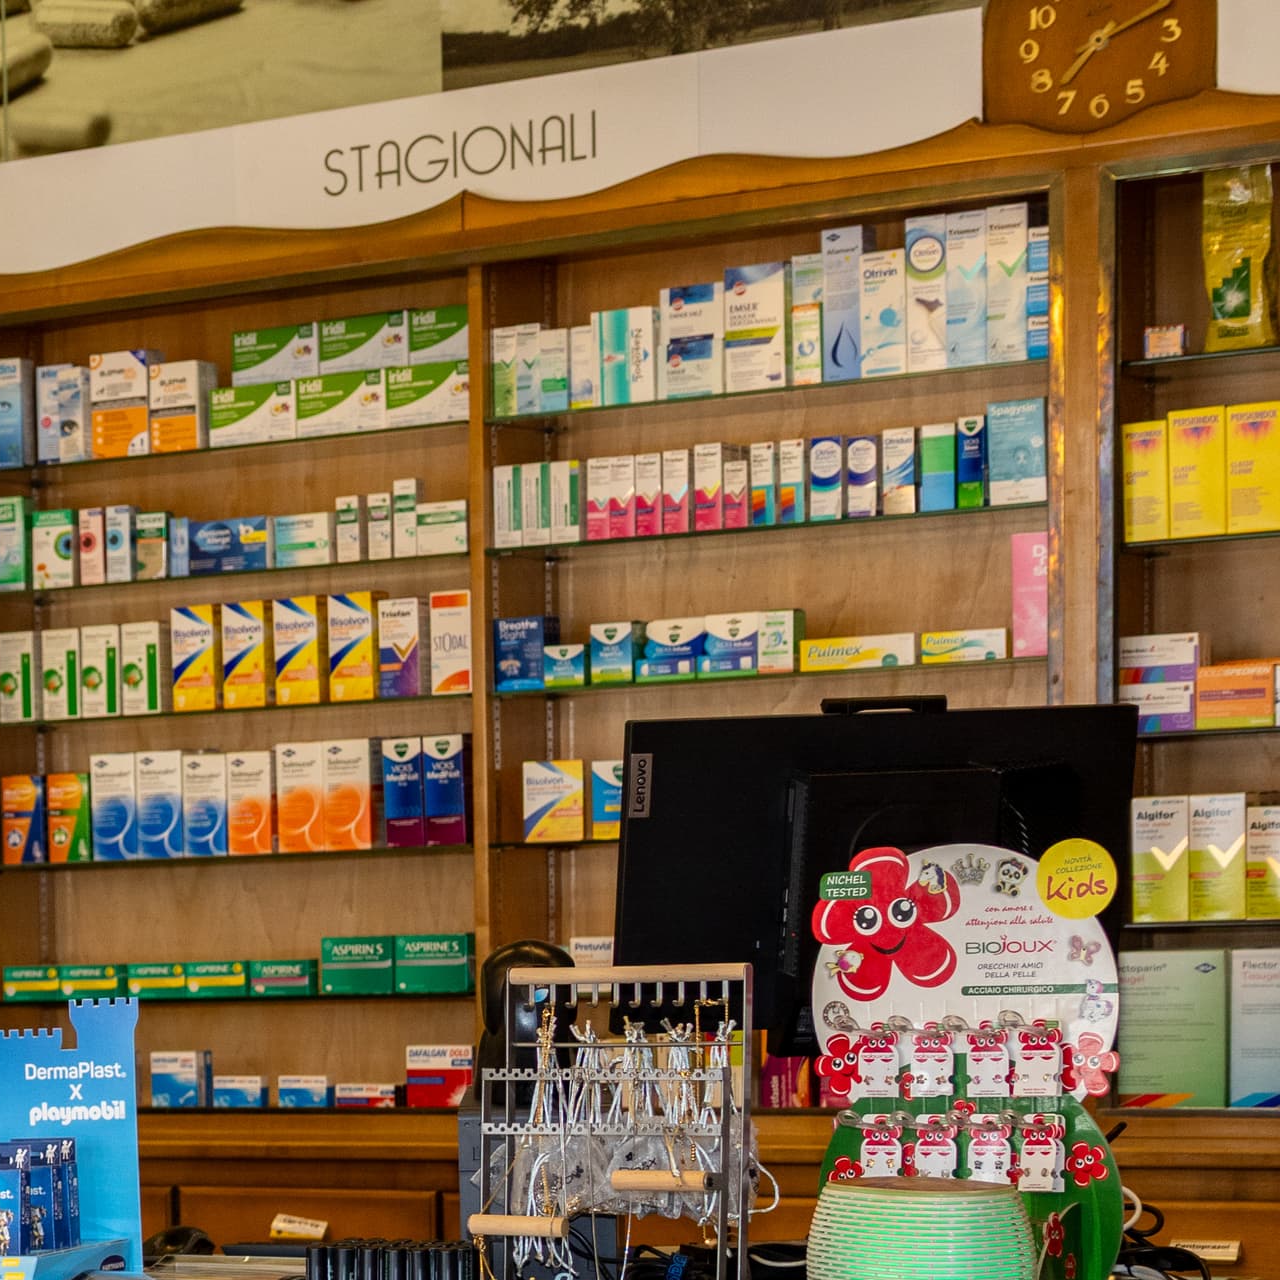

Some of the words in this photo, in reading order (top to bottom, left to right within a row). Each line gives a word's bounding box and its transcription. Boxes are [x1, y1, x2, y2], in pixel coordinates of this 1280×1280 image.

[1029, 6, 1056, 30] 10
[1161, 19, 1182, 42] 3
[1020, 39, 1039, 62] 9
[1148, 52, 1170, 76] 4
[1031, 69, 1052, 92] 8
[1126, 79, 1144, 103] 5
[1057, 91, 1076, 114] 7
[1090, 94, 1109, 118] 6
[323, 111, 596, 197] STAGIONALI
[807, 645, 862, 660] Pulmex
[634, 759, 647, 812] Lenovo
[826, 875, 866, 886] NICHEL
[826, 886, 867, 897] TESTED
[1046, 873, 1108, 900] kids
[1030, 916, 1054, 925] salute
[968, 986, 1002, 994] ACCIAIO
[69, 1084, 83, 1100] X
[29, 1101, 126, 1126] playmobil
